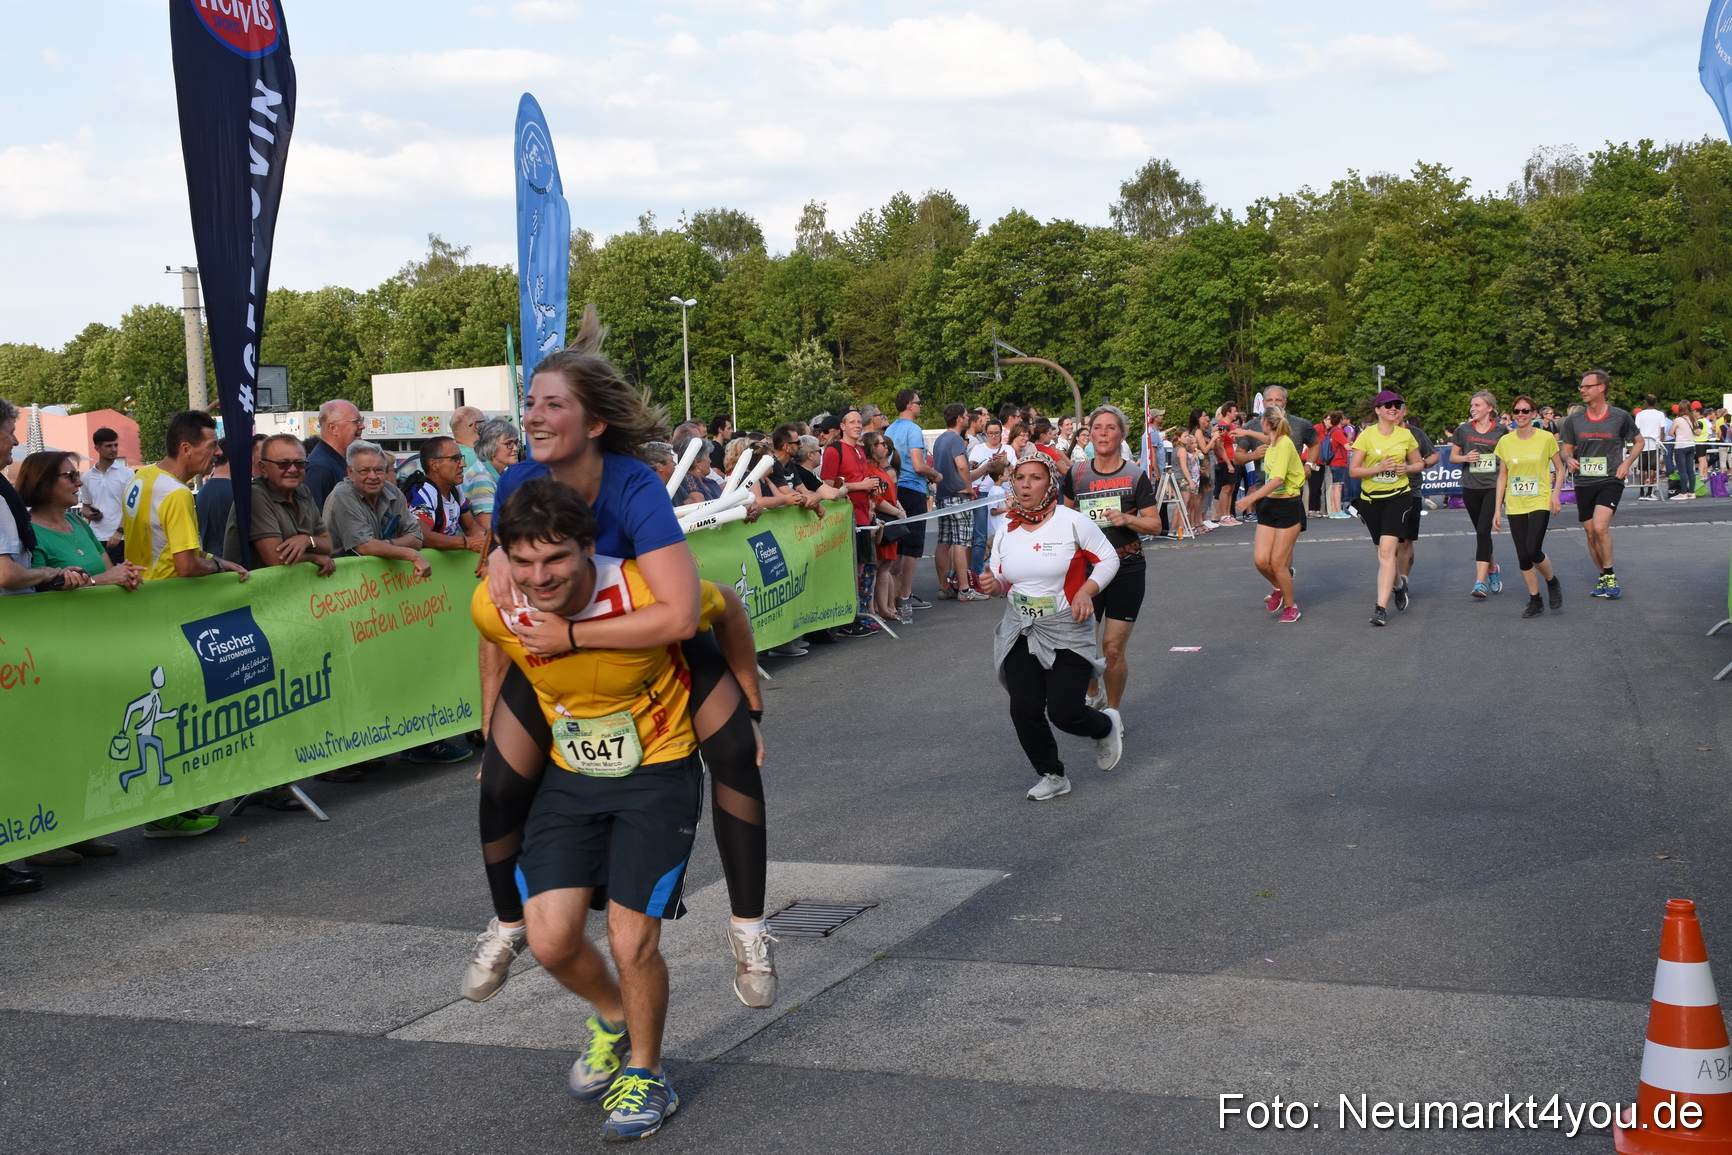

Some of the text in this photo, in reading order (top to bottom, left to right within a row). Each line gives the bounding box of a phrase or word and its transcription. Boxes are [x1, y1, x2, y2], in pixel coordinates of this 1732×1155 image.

[1583, 463, 1604, 471] 1776
[126, 484, 140, 509] B
[1089, 476, 1133, 492] HAARE
[1513, 482, 1535, 491] 1217
[760, 546, 778, 560] Fischer
[310, 573, 381, 620] Gesunde
[754, 561, 809, 617] firmenlauf
[350, 584, 452, 644] laufen länger!
[1021, 605, 1044, 619] 361
[207, 633, 255, 657] Fischer
[219, 646, 257, 664] AUTOMOBILE
[0, 647, 40, 690] er!
[176, 652, 332, 755] firmenlauf
[294, 697, 473, 764] www.firmenlauf-oberpfalz.de
[183, 732, 256, 774] neumarkt
[567, 736, 625, 761] 1647
